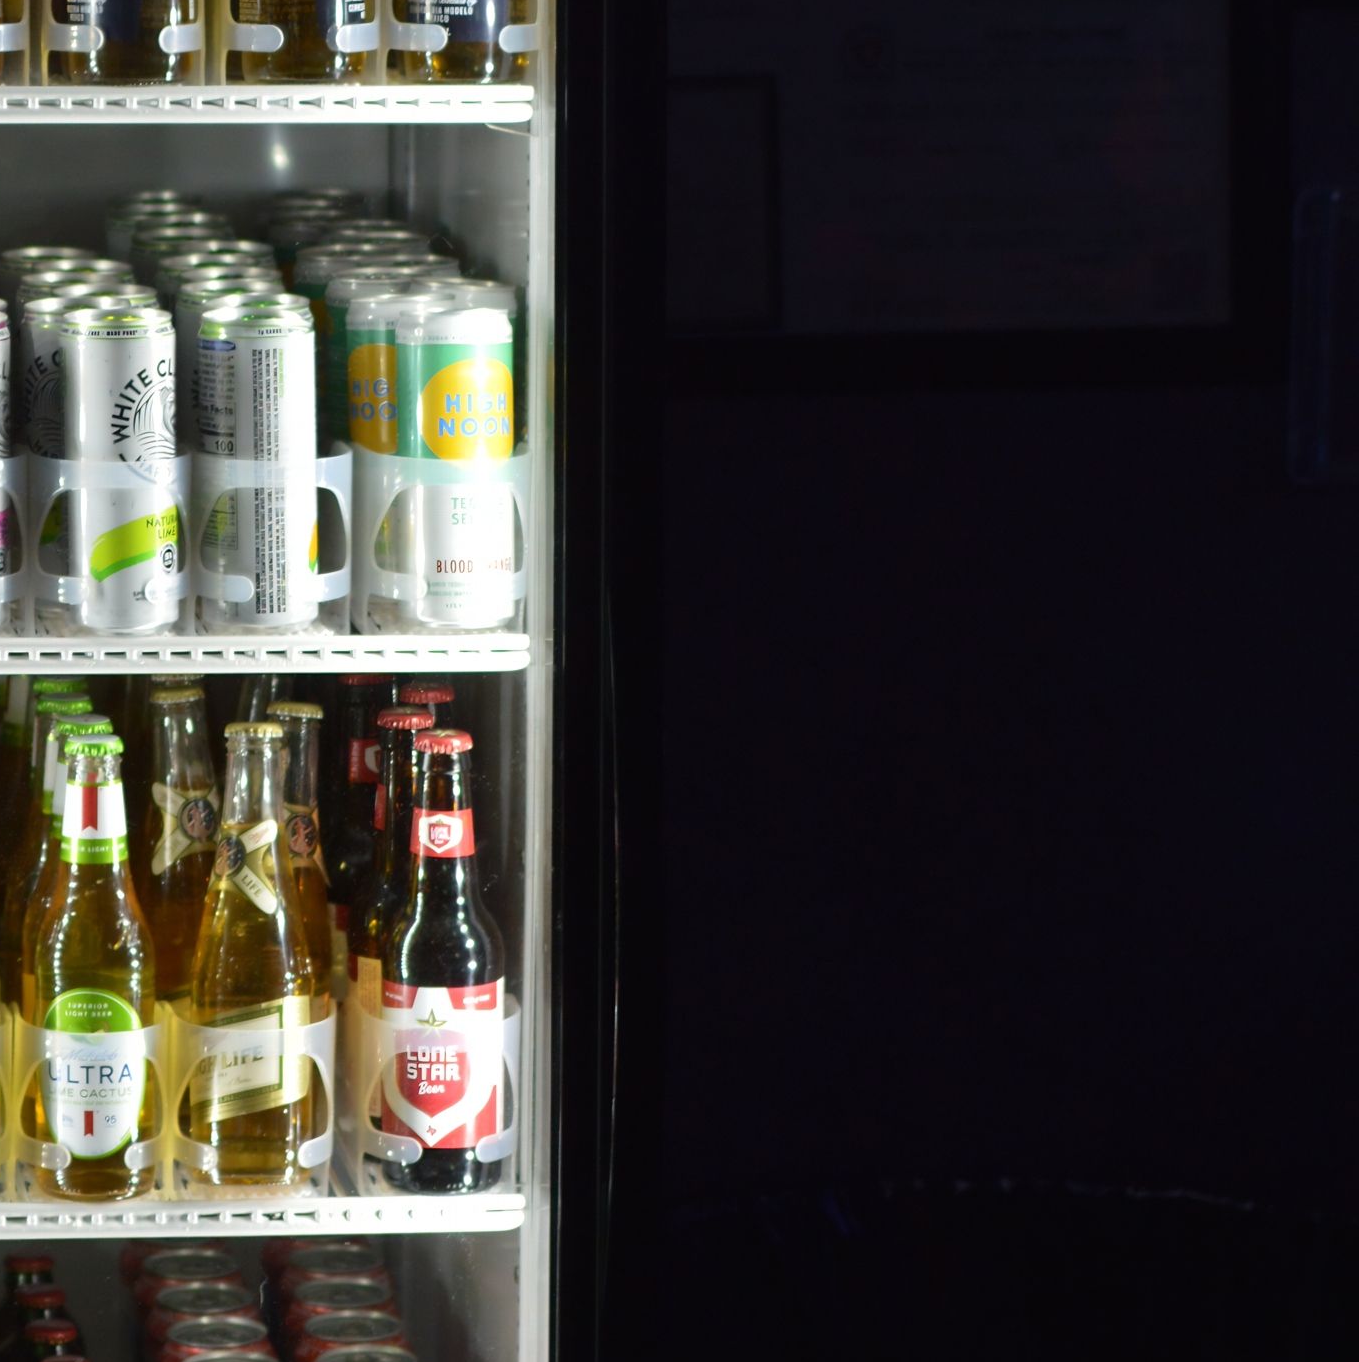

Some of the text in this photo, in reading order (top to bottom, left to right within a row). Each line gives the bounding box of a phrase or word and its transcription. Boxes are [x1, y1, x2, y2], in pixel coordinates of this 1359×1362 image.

[110, 367, 154, 446] WHITE
[445, 392, 507, 414] HIGH
[438, 417, 511, 437] NOON
[436, 558, 474, 574] BLOOD
[407, 1044, 458, 1062] LONE
[48, 1060, 133, 1085] ULTRA
[407, 1062, 461, 1081] STAR
[418, 1081, 445, 1095] Beer
